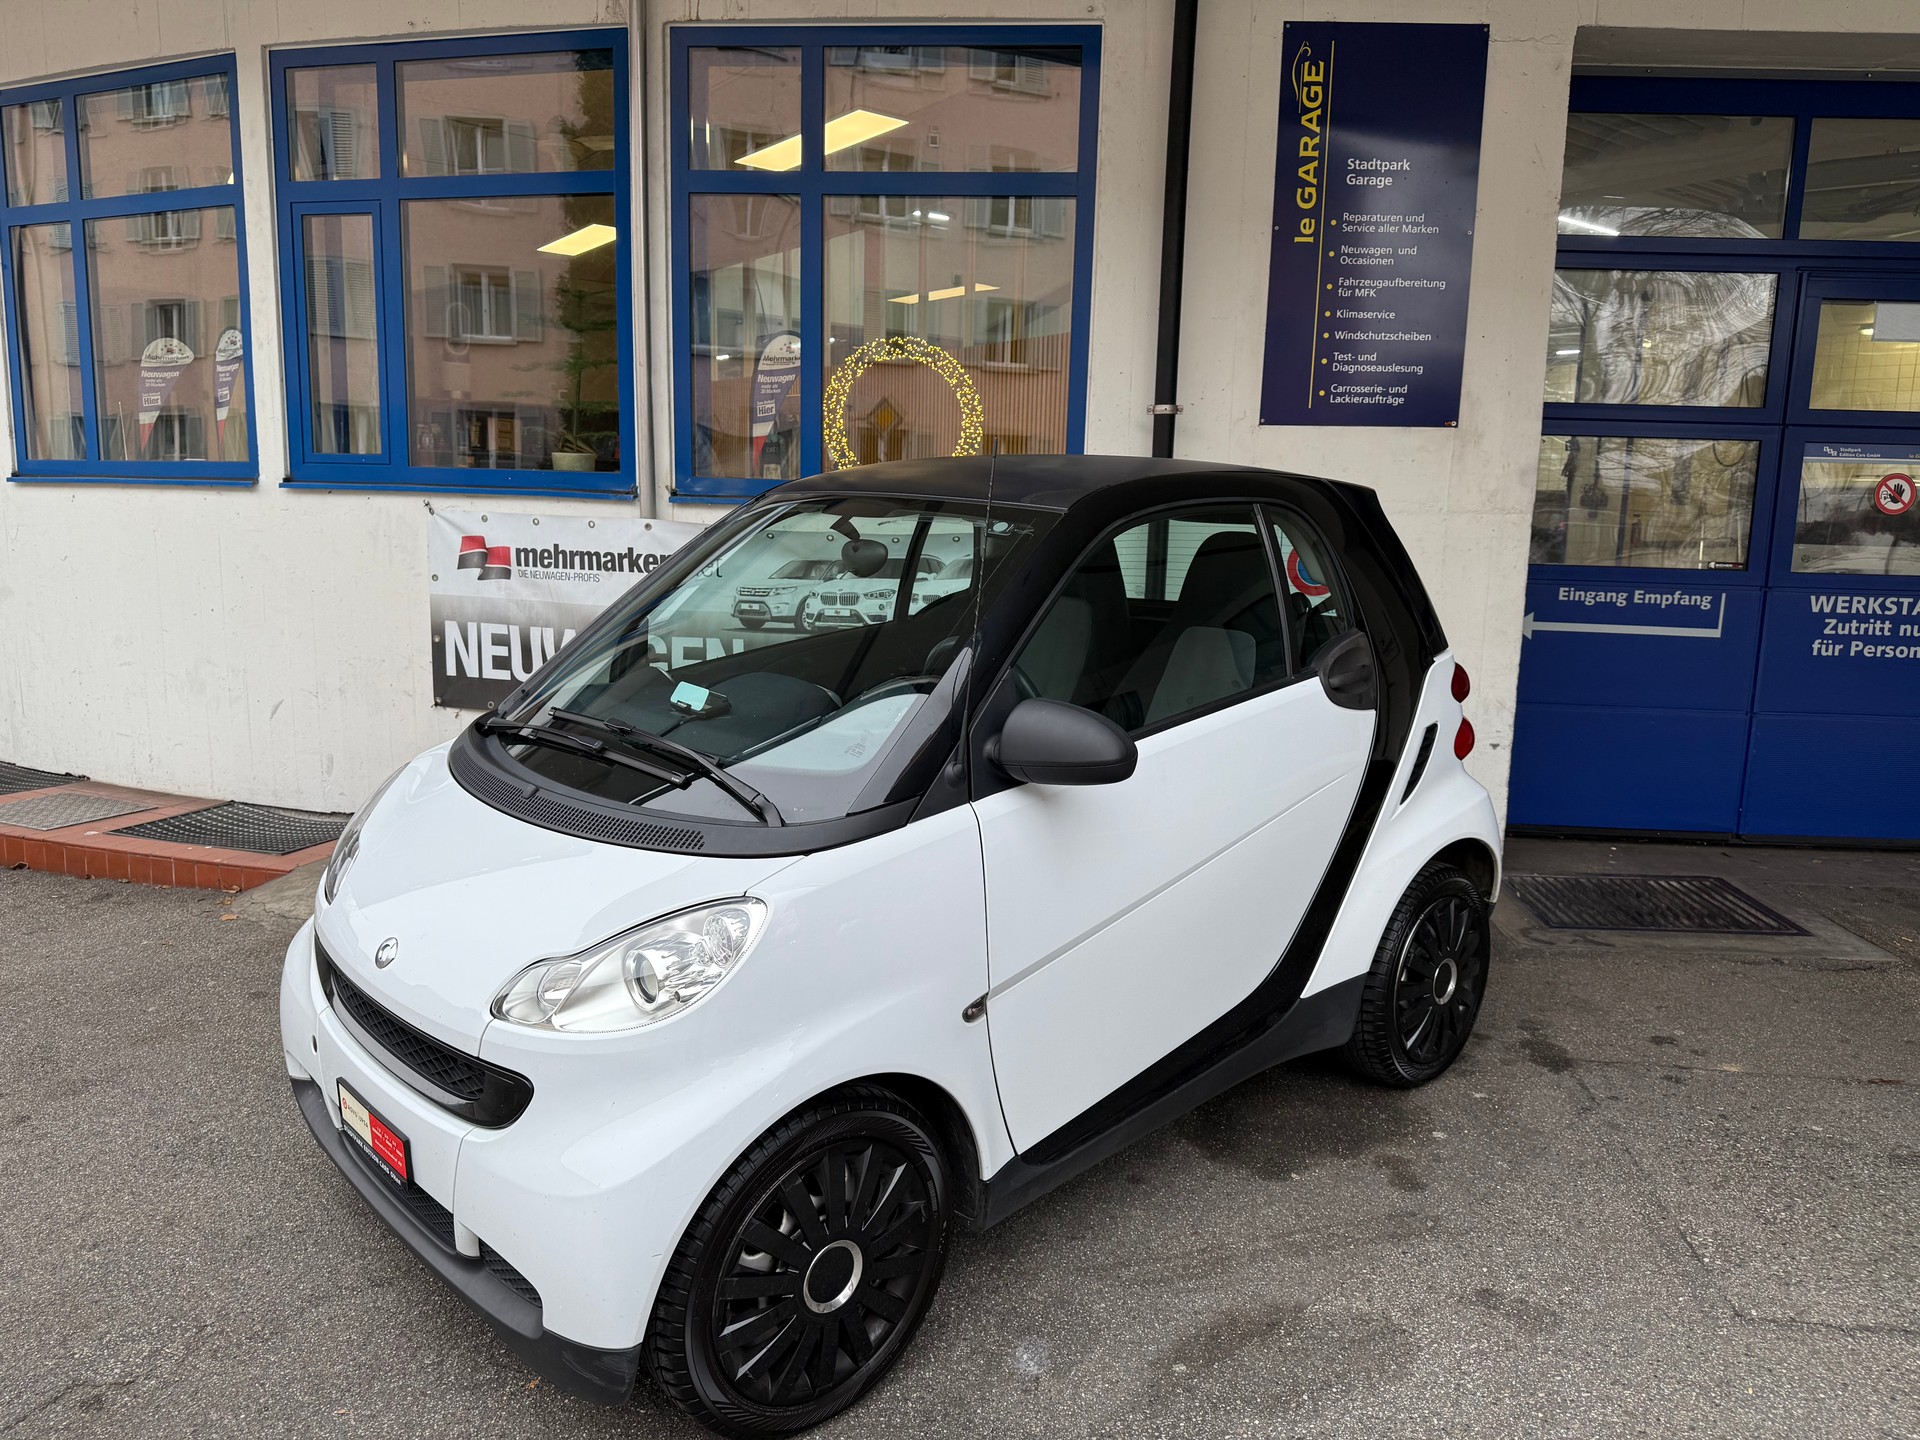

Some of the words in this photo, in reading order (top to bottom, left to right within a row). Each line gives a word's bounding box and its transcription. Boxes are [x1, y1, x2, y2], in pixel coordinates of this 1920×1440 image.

[1296, 60, 1325, 210] GARAGE
[1347, 158, 1411, 172] Stadtpark
[1346, 174, 1393, 188] Garage
[1343, 212, 1402, 223] Reparaturen
[1405, 213, 1425, 222] und
[1294, 217, 1315, 243] le
[1342, 223, 1376, 233] Service
[1378, 224, 1399, 233] aller
[1402, 225, 1439, 234] Marken
[1340, 245, 1393, 256] Neuwagen
[1398, 245, 1418, 255] und
[1340, 256, 1394, 265] Occasionen
[1338, 277, 1446, 290] Fahrzeugaufbereitung
[1338, 288, 1352, 297] für
[1355, 289, 1377, 297] MFK
[1336, 309, 1396, 319] Klimaservice
[1334, 330, 1432, 341] Windschutzscheiben
[1333, 351, 1355, 361] Test-
[1358, 352, 1377, 361] und
[1332, 362, 1424, 375] Diagnoseauslesung
[757, 373, 796, 384] Neuwagen
[1330, 383, 1387, 393] Carrosserie-
[1388, 384, 1408, 394] und
[1330, 394, 1405, 406] Lackieraufträge
[758, 405, 774, 416] Hier
[518, 570, 529, 578] DIE
[530, 570, 600, 583] NEUWAGEN-PROFIS
[1558, 587, 1628, 607] Eingang
[1633, 590, 1713, 610] Empfang
[1823, 618, 1892, 636] Zutritt
[1812, 639, 1844, 656] für
